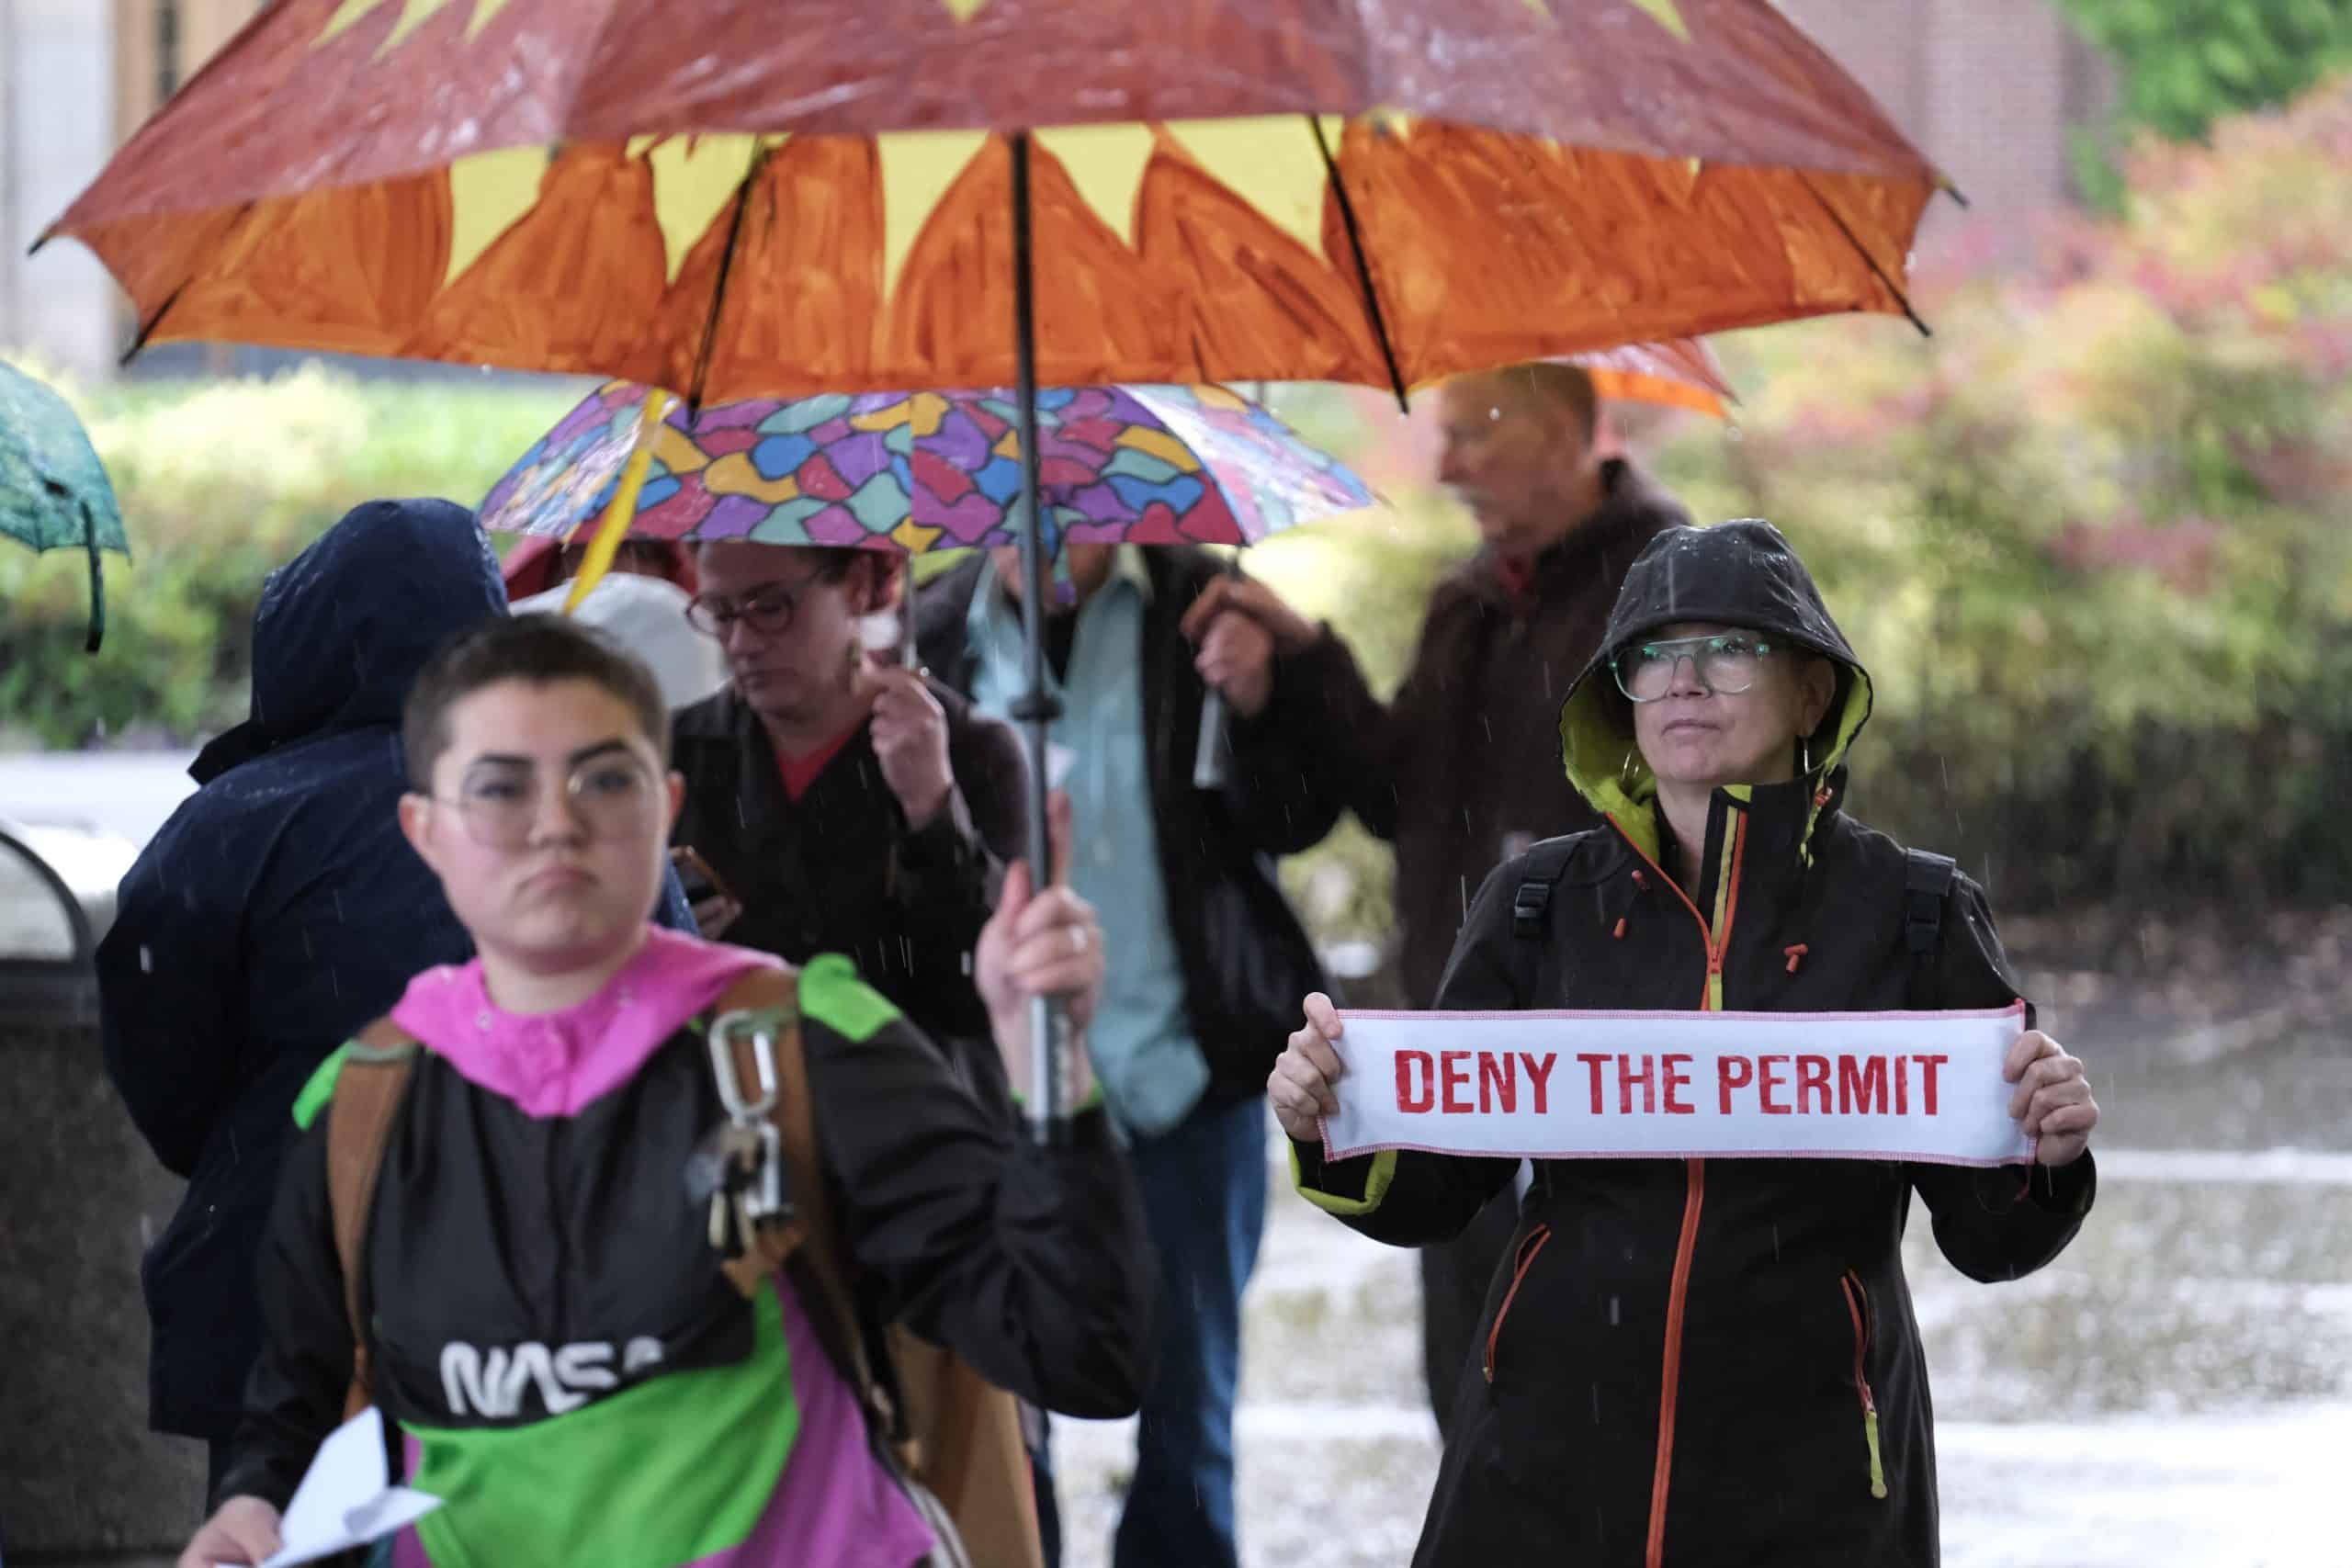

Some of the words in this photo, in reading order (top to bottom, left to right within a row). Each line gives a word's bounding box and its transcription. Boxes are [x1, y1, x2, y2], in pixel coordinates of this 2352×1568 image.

[1395, 1049, 1556, 1114] DENY
[1577, 1053, 1695, 1114] THE
[1718, 1054, 1949, 1115] PERMIT
